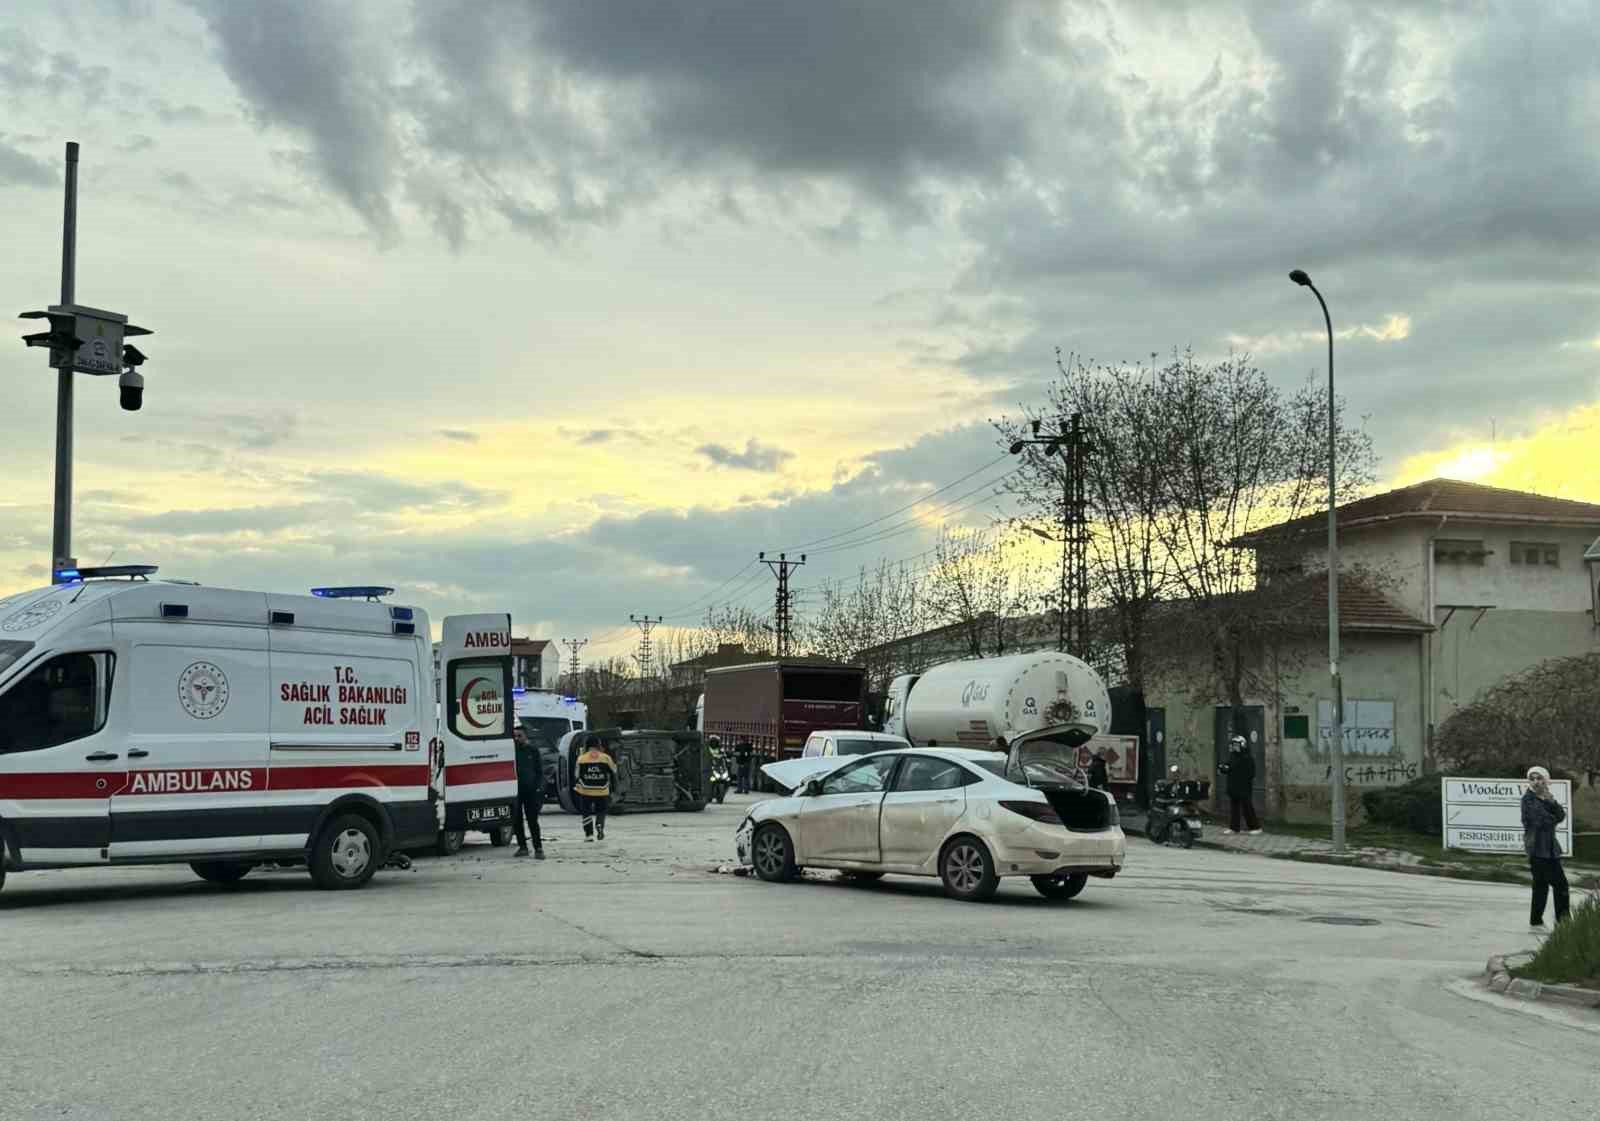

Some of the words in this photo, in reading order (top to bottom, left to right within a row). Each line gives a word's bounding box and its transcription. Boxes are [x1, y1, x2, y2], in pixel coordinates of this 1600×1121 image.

[334, 666, 358, 684] T.C.
[281, 681, 330, 702] SAĞLIK
[338, 685, 407, 704] BAKANLIĞI
[303, 704, 334, 725] ACİL
[340, 705, 386, 726] SAĞLIK
[131, 769, 252, 793] AMBULANS
[1461, 783, 1513, 796] Wooden
